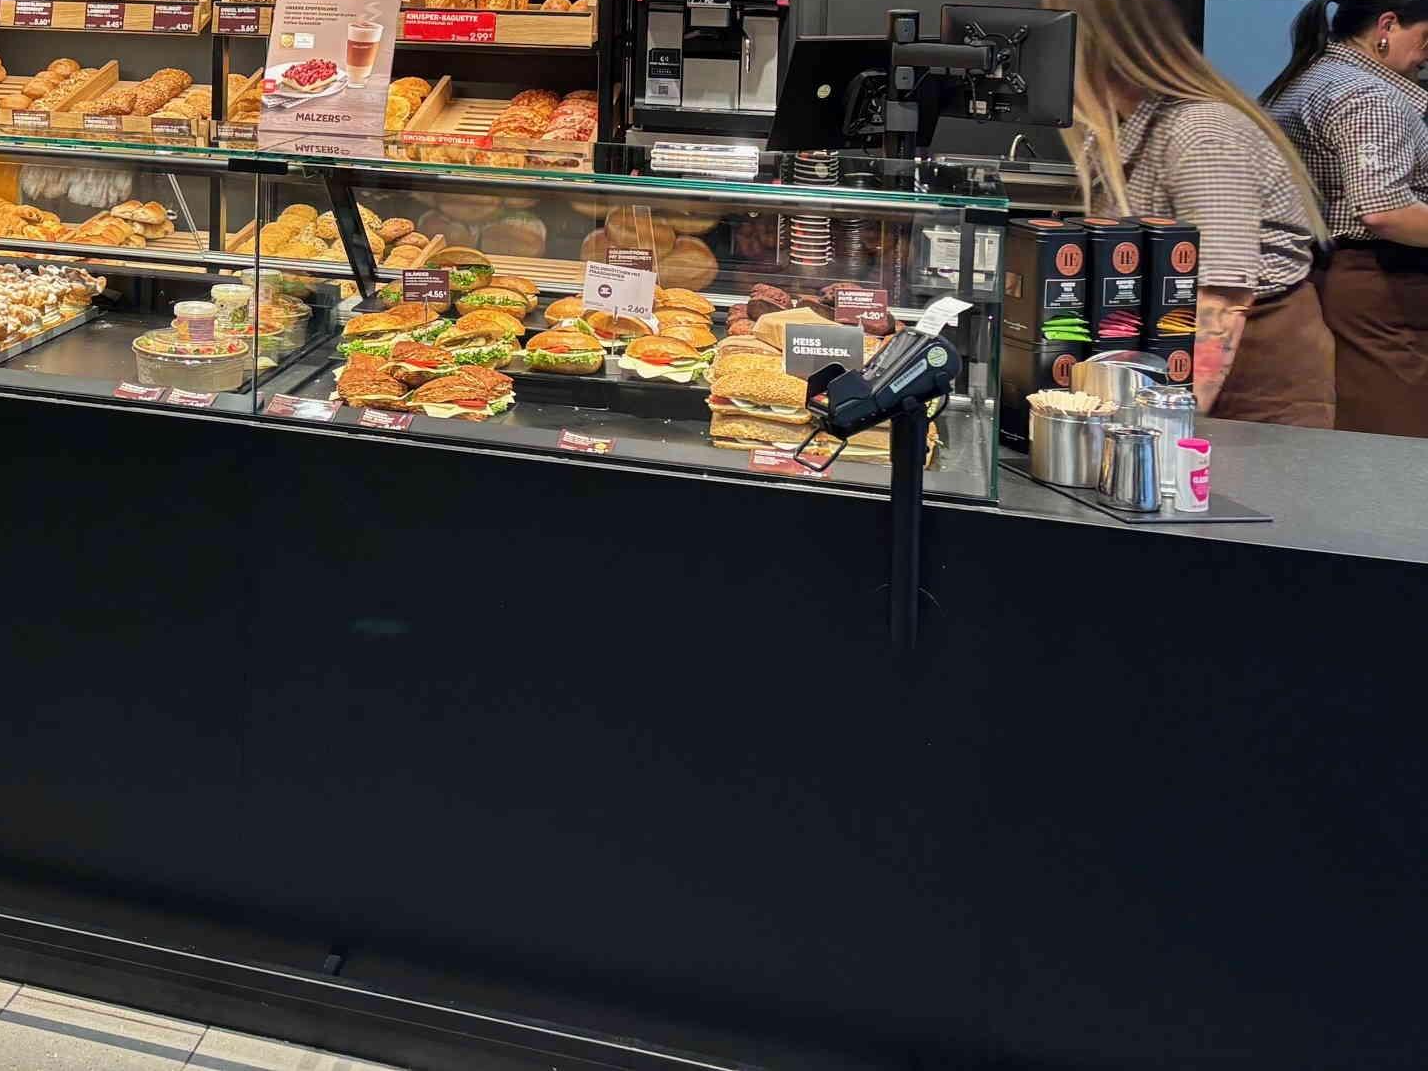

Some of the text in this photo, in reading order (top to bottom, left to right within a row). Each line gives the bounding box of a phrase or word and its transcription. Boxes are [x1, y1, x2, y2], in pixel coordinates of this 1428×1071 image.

[295, 113, 341, 123] MALZERS
[793, 337, 821, 346] HEISS
[793, 346, 851, 357] GENIESSEN.
